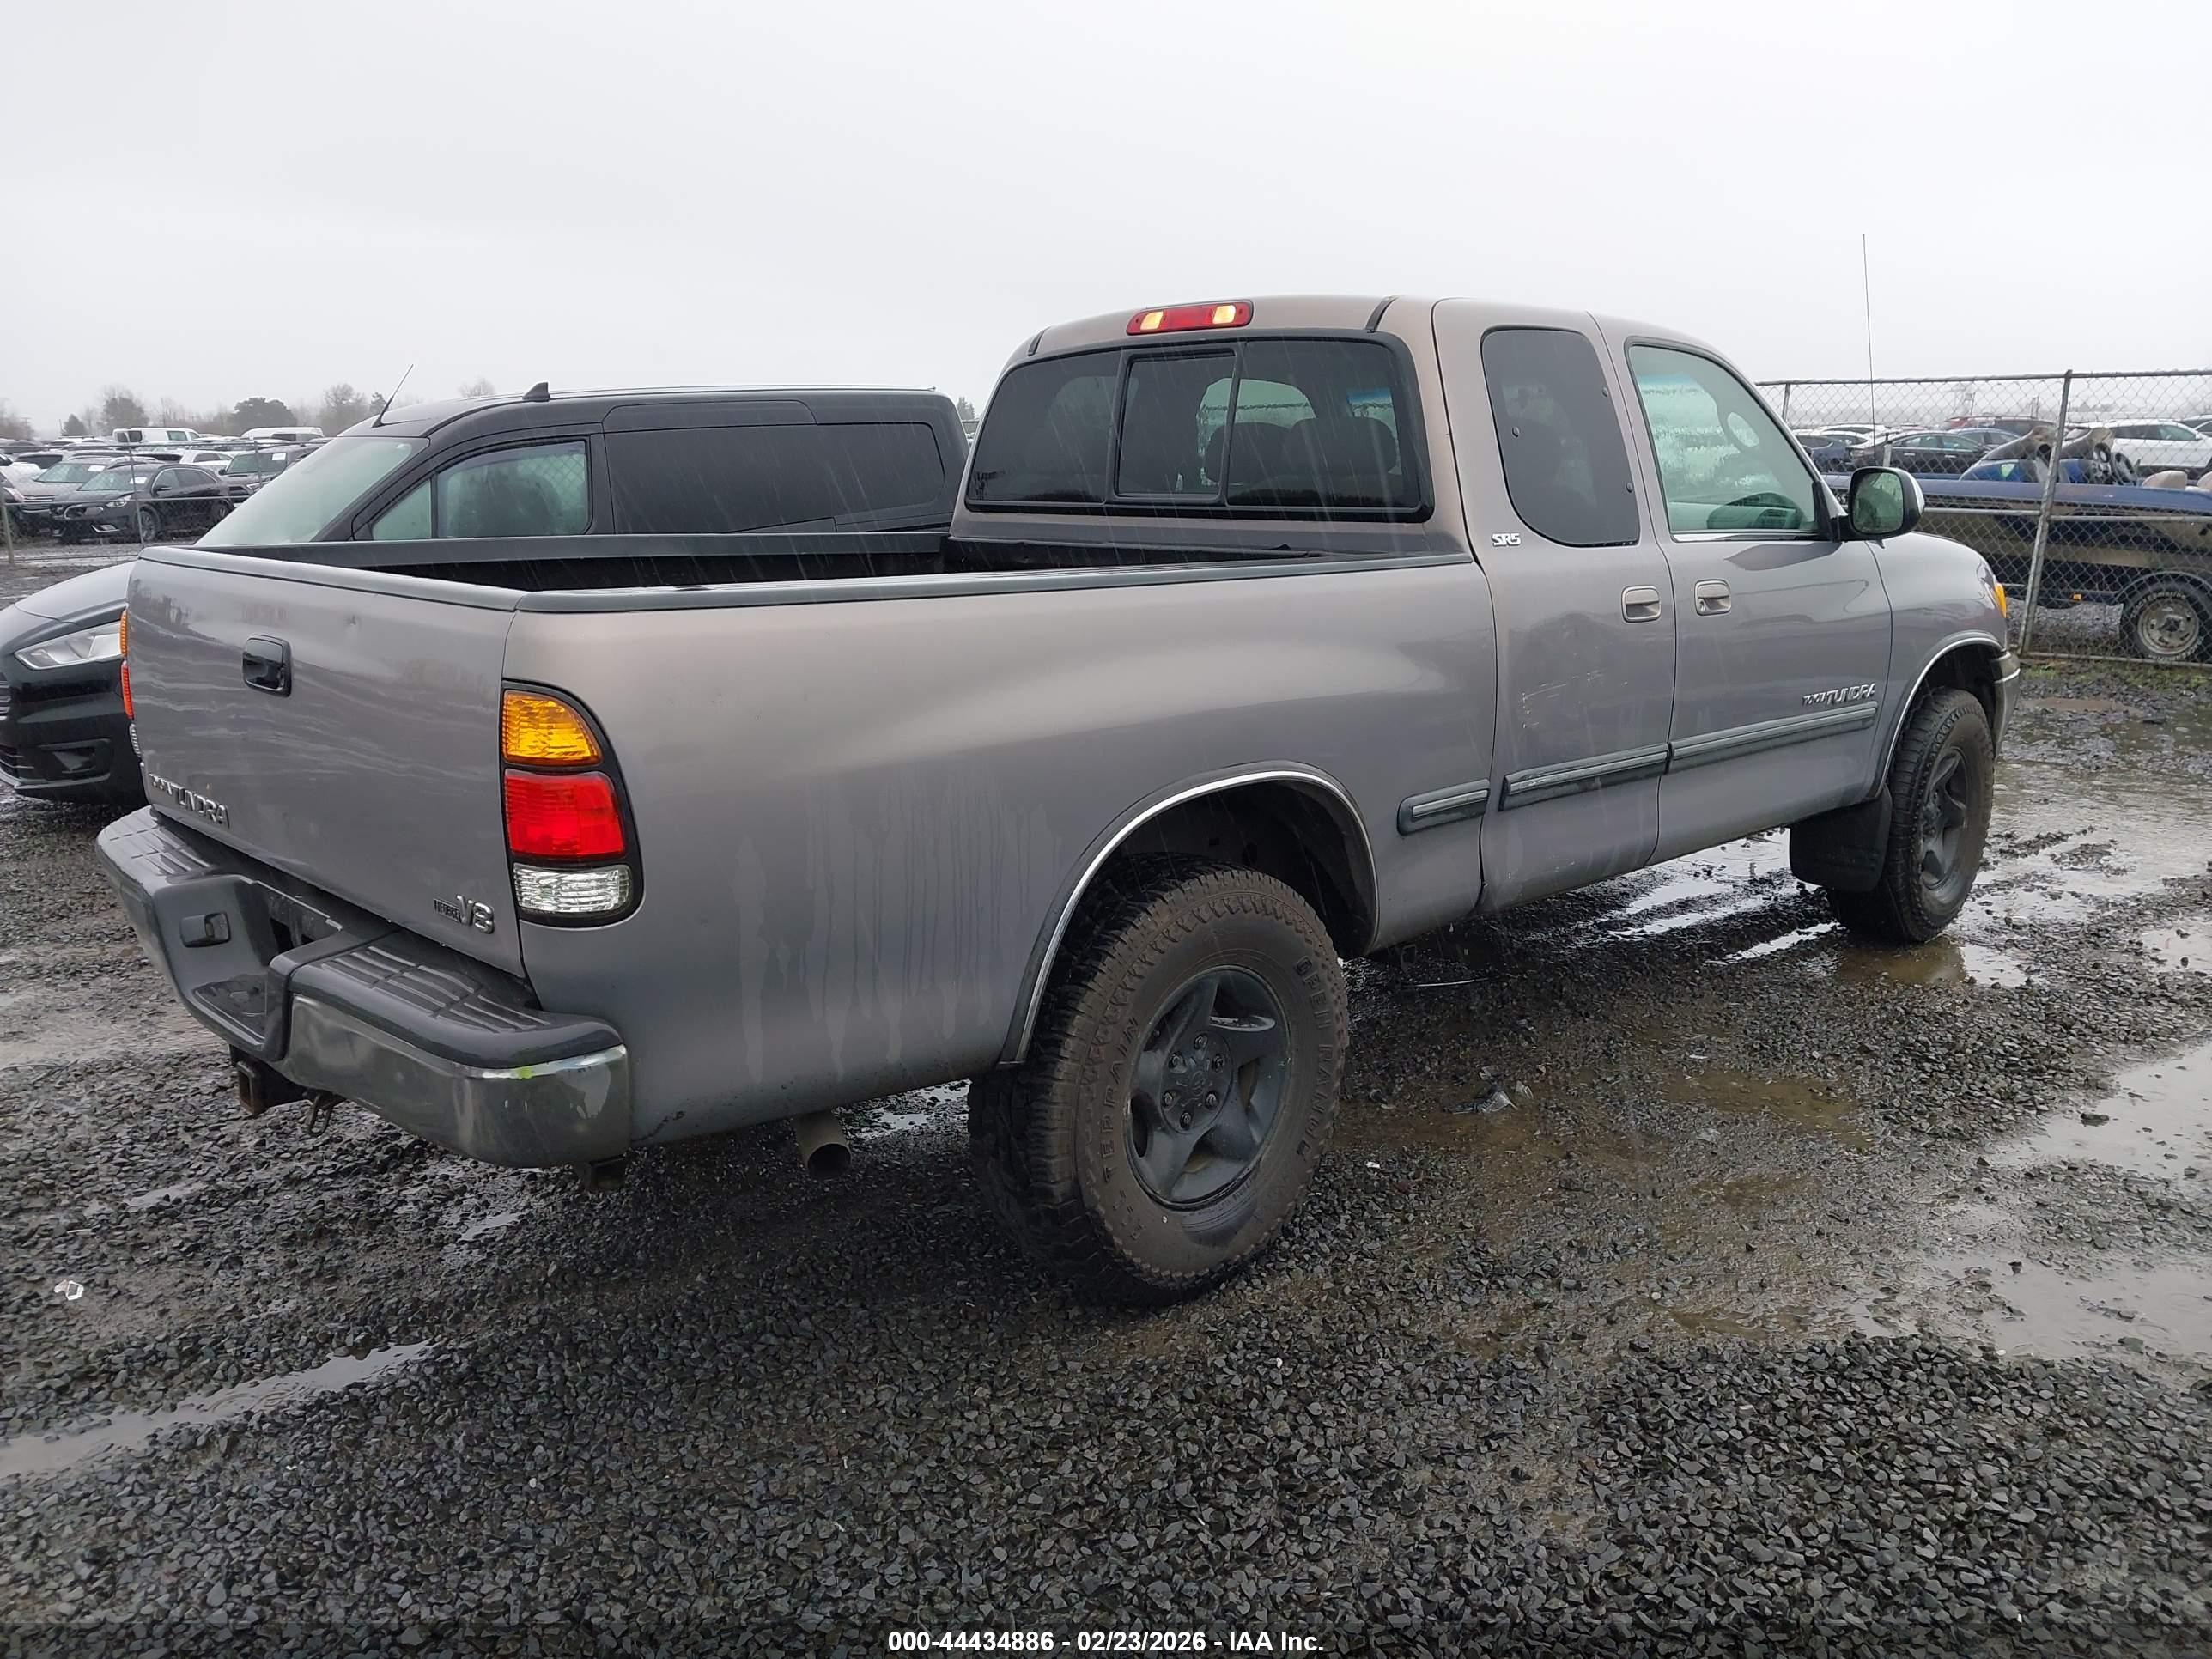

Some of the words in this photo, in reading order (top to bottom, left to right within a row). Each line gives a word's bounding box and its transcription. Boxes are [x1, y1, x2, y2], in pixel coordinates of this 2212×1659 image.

[1492, 533, 1521, 547] SR5
[1826, 683, 1876, 704] TUNDRA
[170, 781, 229, 829] TUNDRA
[454, 895, 494, 933] V8
